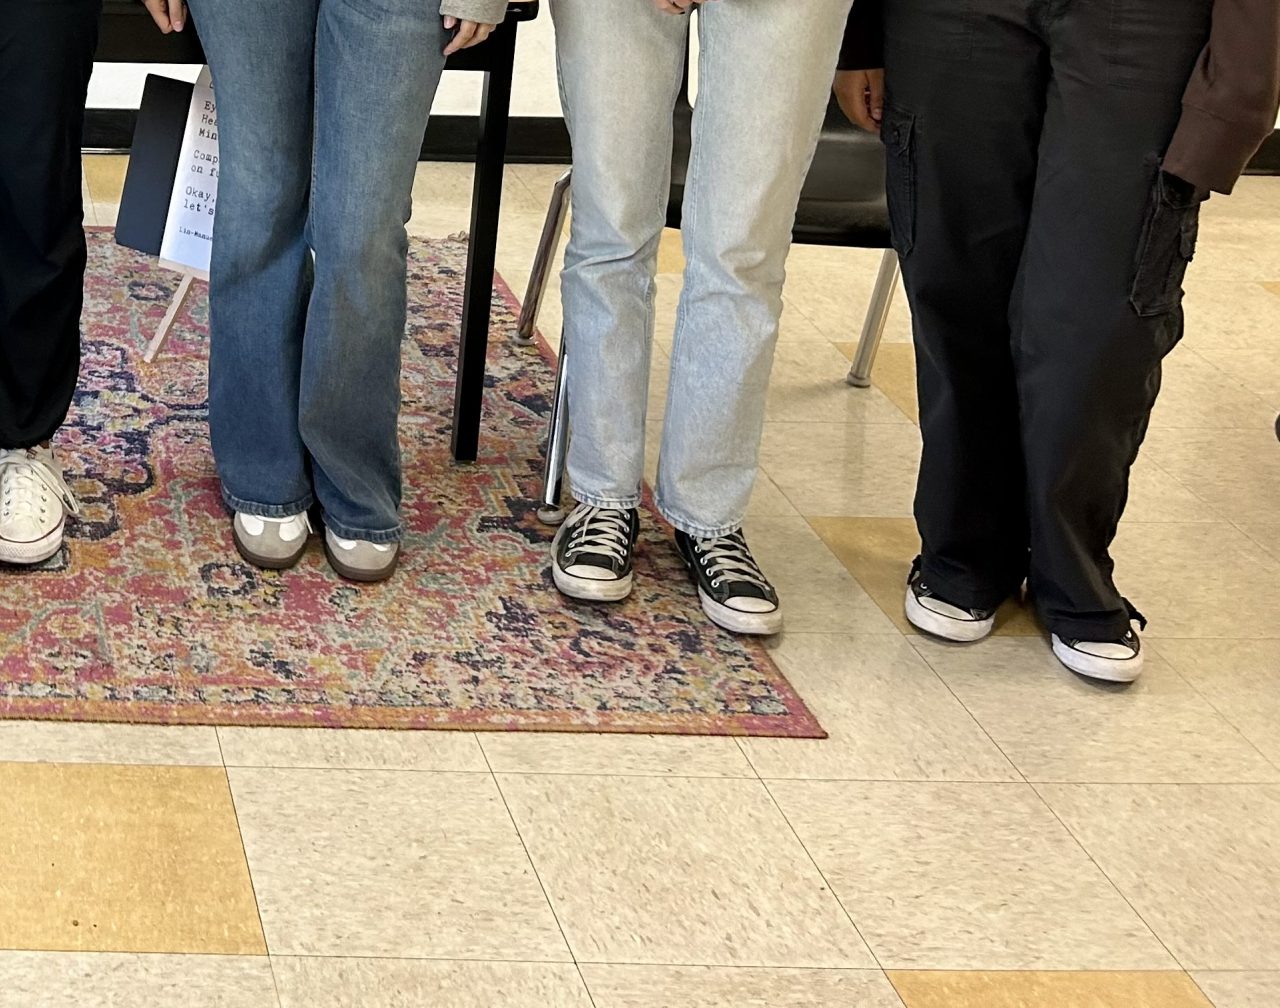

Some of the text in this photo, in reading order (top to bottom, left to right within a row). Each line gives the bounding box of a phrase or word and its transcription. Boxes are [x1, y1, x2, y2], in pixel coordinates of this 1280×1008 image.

[193, 149, 218, 166] Comp
[190, 164, 204, 175] on
[185, 186, 216, 204] Okay,
[183, 198, 215, 217] let's
